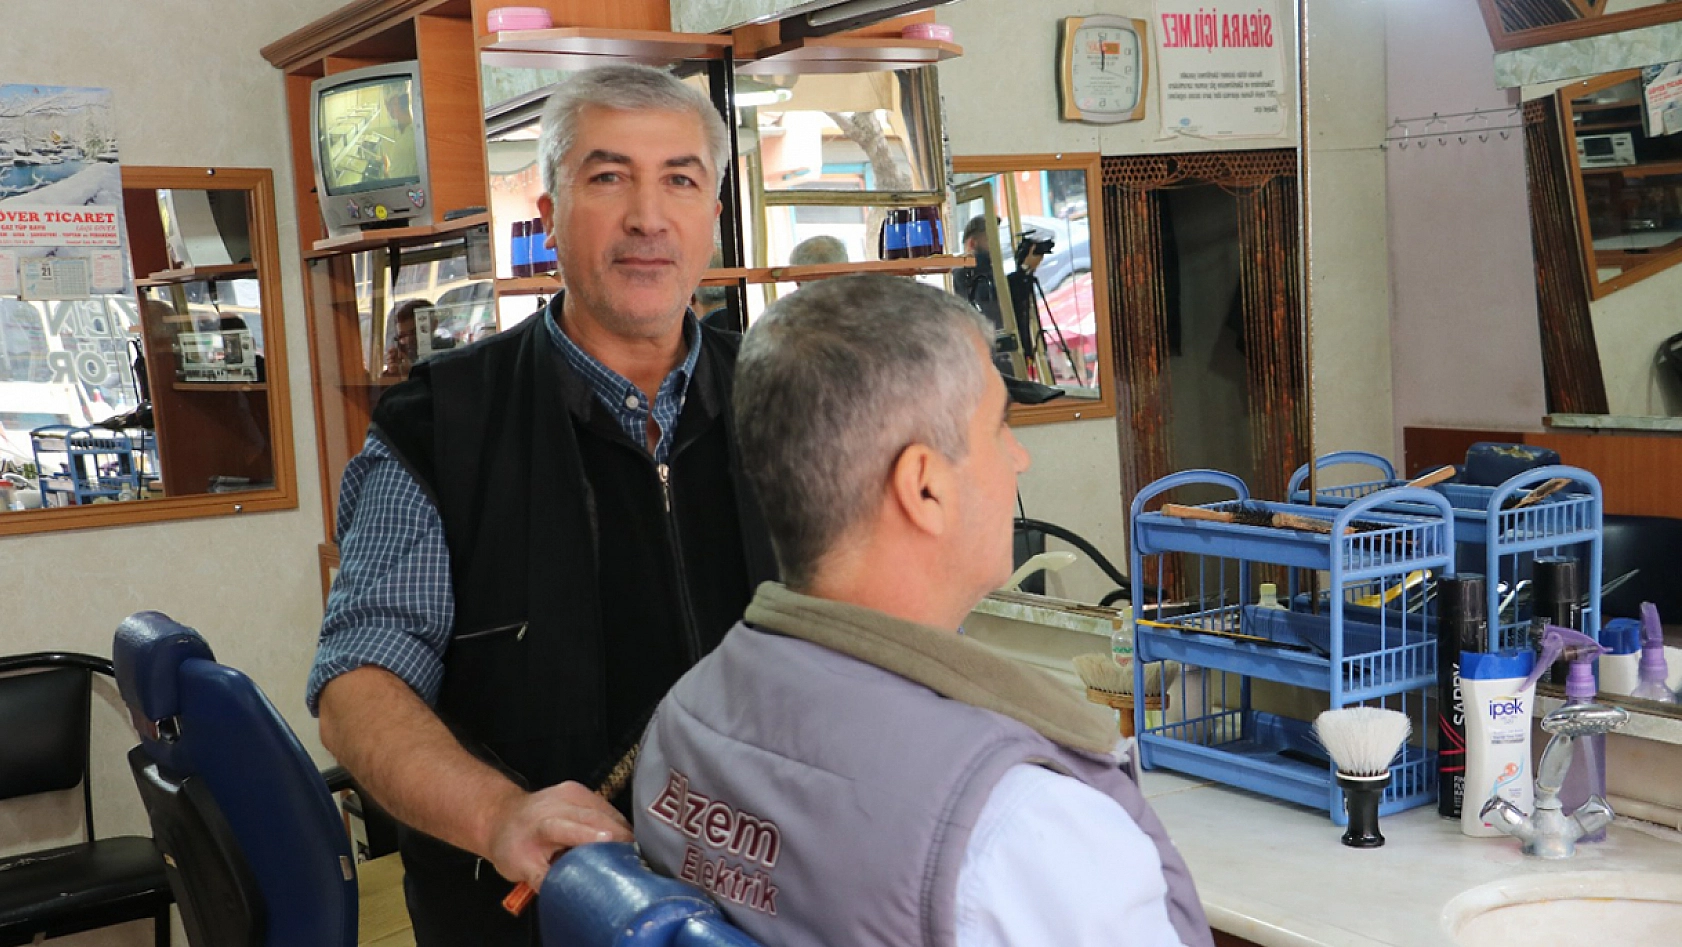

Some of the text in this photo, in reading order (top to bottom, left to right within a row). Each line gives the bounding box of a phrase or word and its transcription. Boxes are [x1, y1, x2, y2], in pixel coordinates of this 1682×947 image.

[44, 210, 114, 222] TİCARET
[41, 267, 51, 277] 21
[1489, 697, 1524, 719] ipek
[679, 842, 778, 915] Elektrik
